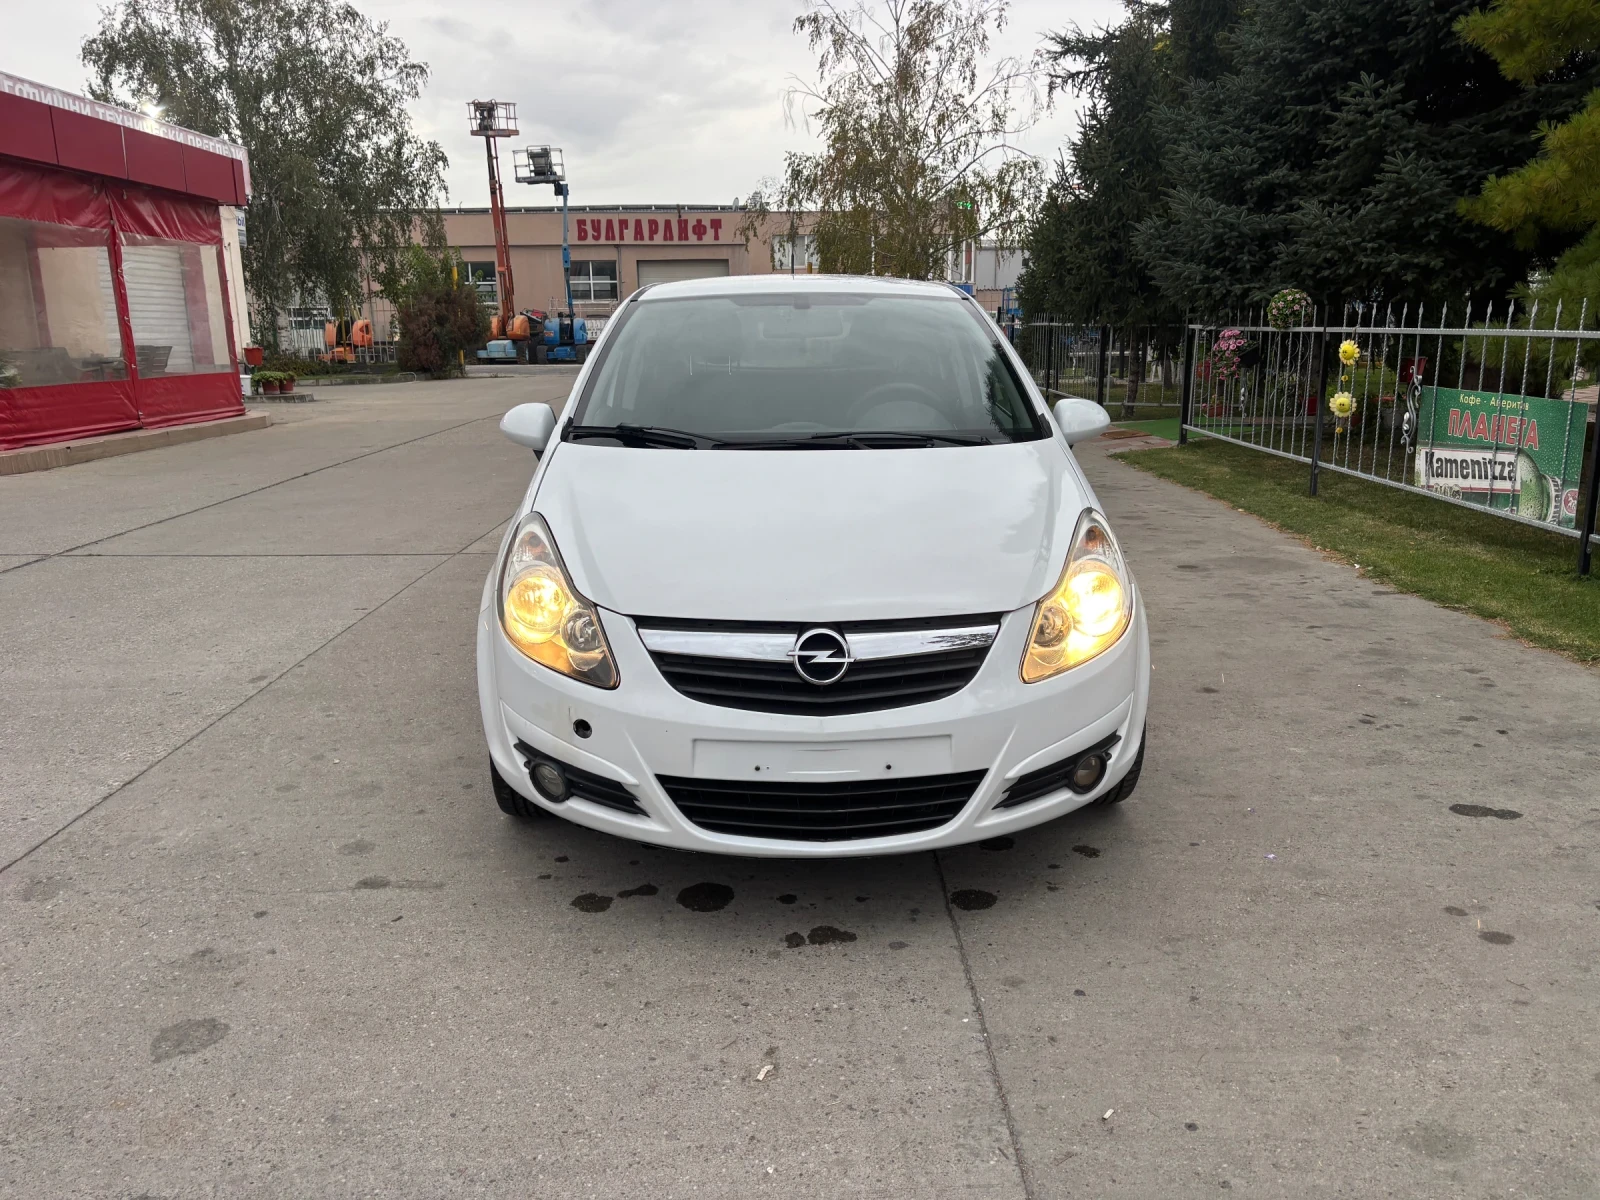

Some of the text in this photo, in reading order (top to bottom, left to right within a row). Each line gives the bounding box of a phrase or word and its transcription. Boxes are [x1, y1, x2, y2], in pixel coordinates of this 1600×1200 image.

[576, 218, 722, 241] БУЛГАРЛИФТ
[1448, 408, 1538, 450] ПЛАНЕТА
[1424, 450, 1517, 482] Kamenitza
